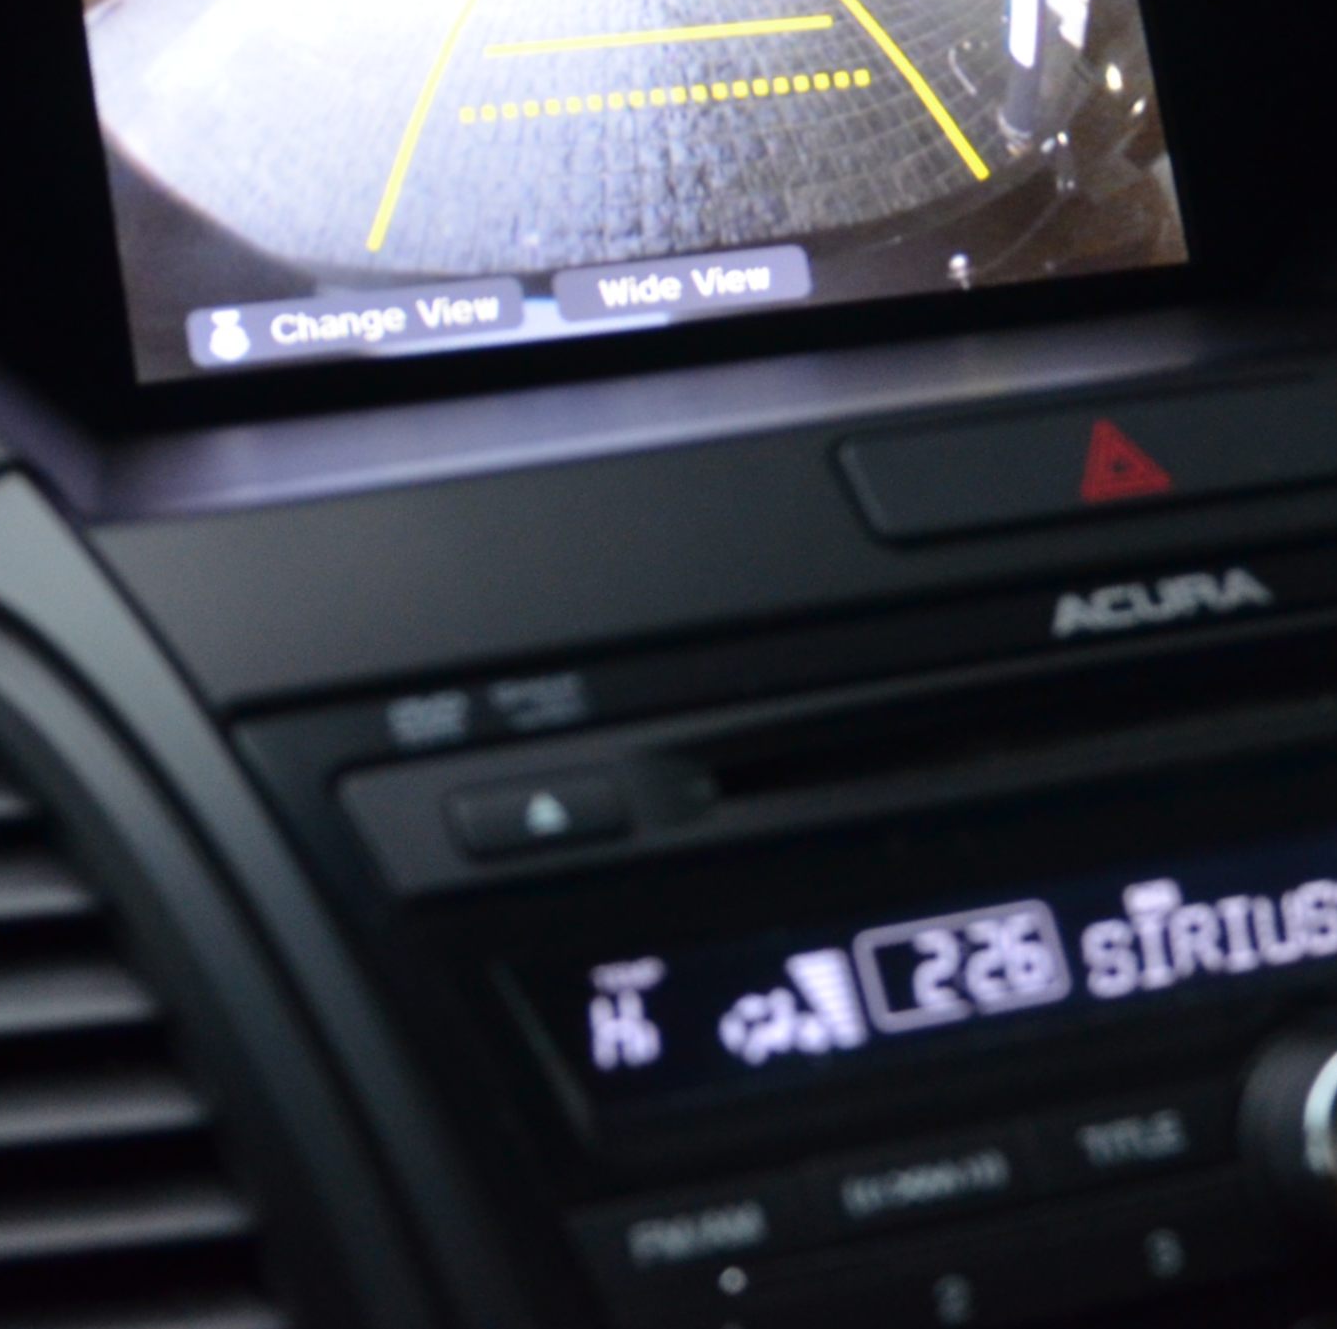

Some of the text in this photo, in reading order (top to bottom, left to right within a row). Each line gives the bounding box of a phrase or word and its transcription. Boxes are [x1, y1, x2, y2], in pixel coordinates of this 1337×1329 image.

[599, 264, 772, 308] Wide View
[269, 291, 500, 347] Change View
[1051, 566, 1271, 636] ACURA
[912, 913, 1054, 1009] 226
